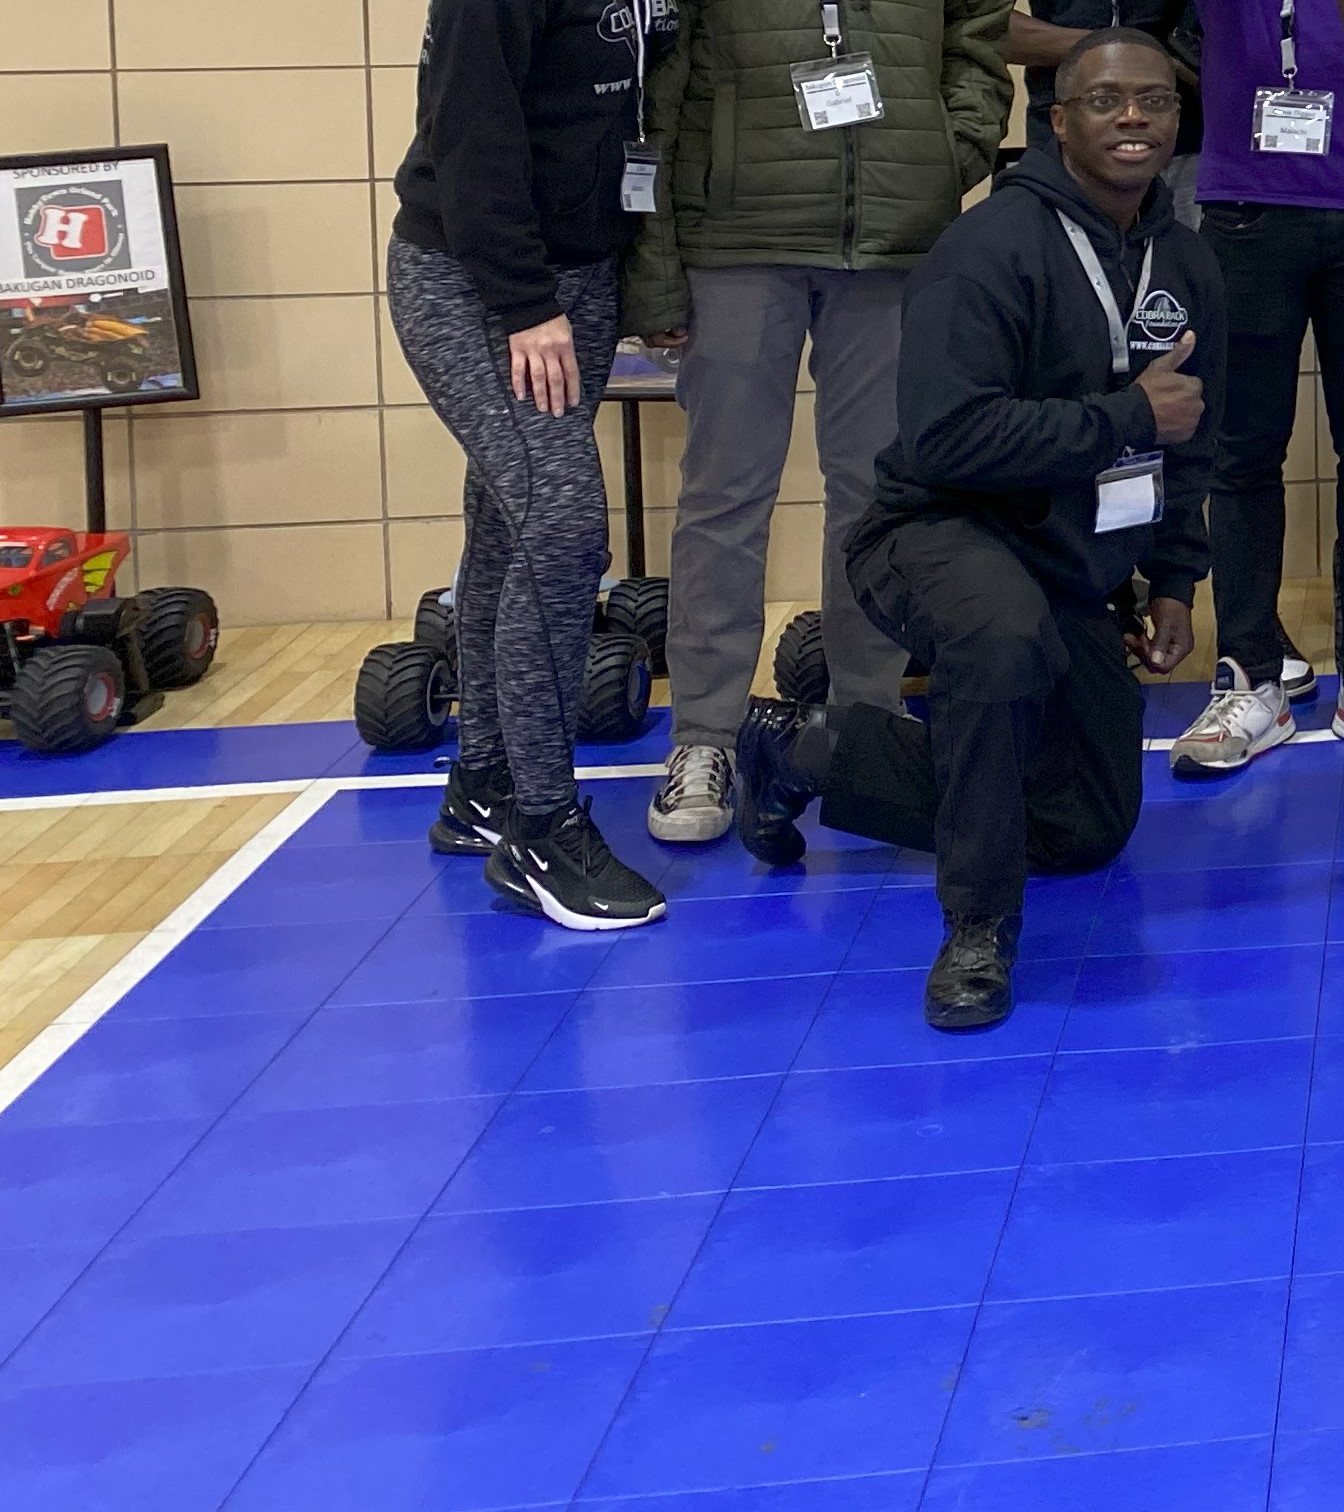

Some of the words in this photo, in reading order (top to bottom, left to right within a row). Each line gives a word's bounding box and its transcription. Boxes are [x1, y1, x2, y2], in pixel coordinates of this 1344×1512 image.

[13, 163, 98, 179] SPONSORED
[103, 161, 120, 172] BY
[65, 269, 156, 288] DRAGONOID
